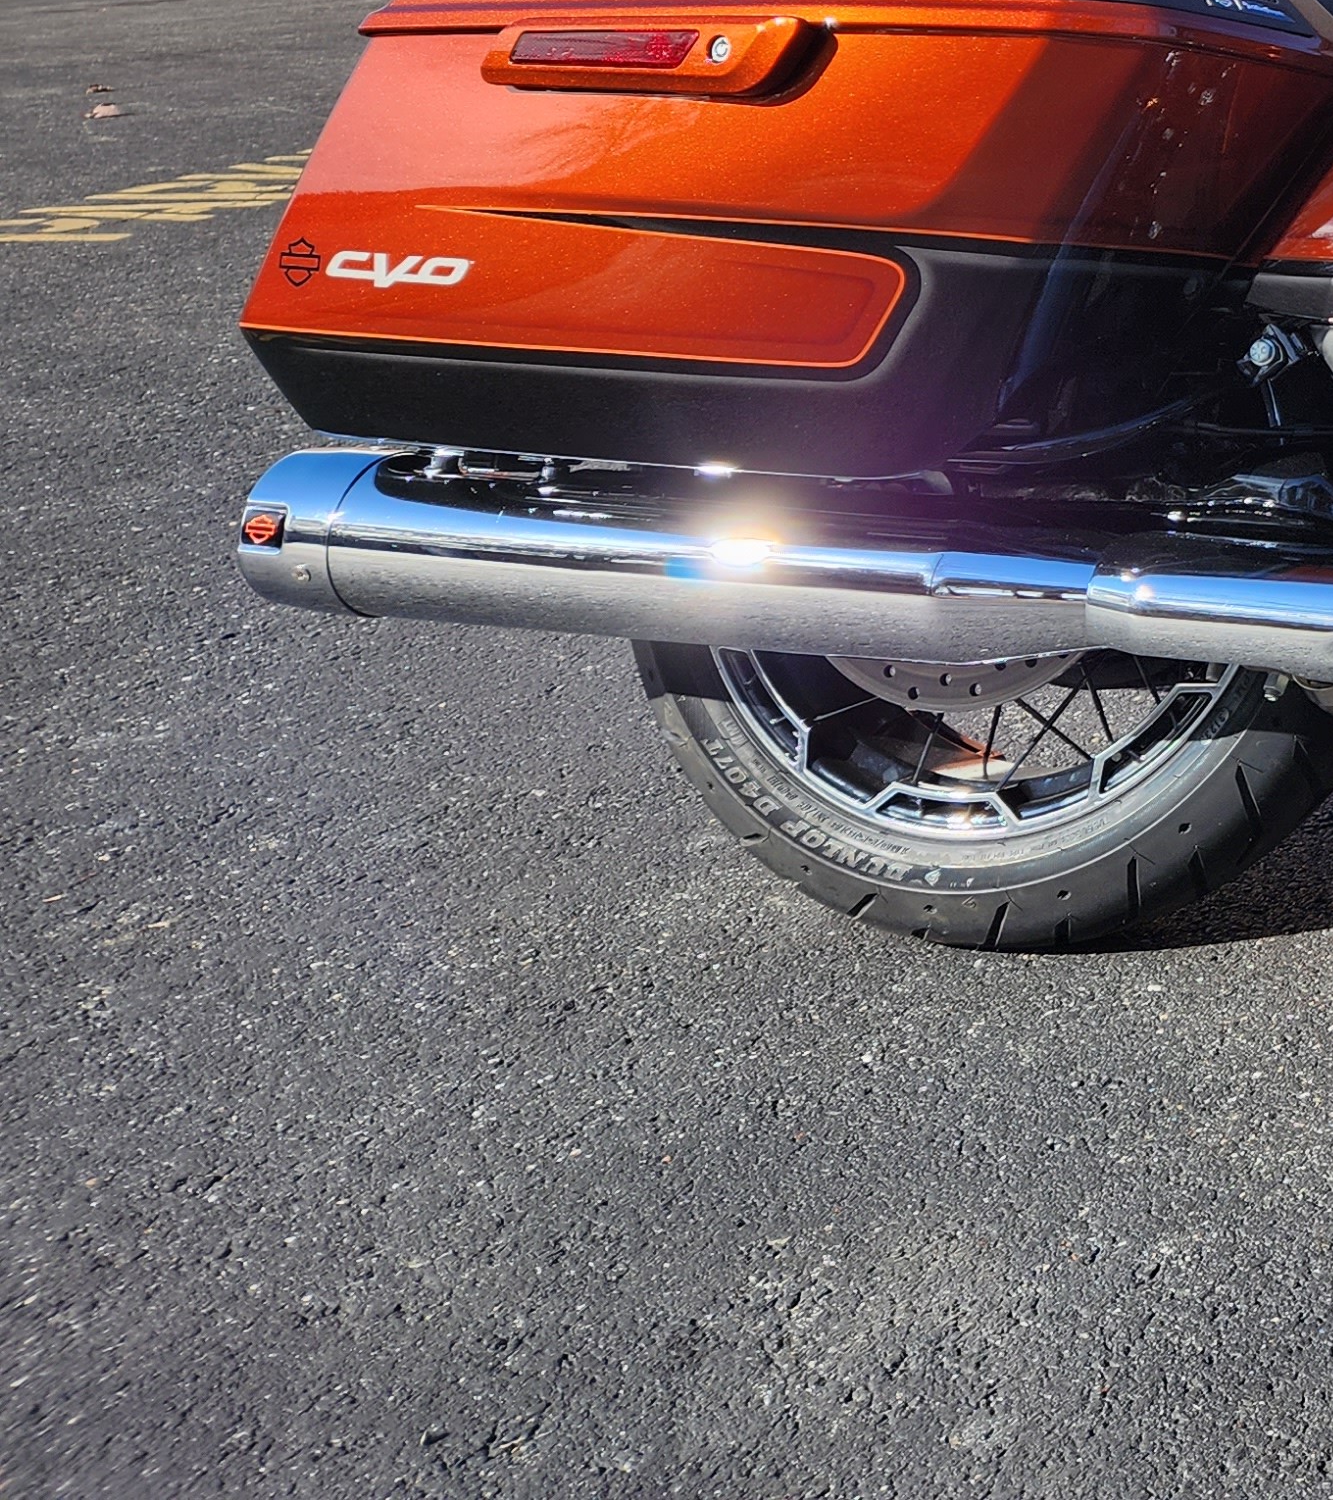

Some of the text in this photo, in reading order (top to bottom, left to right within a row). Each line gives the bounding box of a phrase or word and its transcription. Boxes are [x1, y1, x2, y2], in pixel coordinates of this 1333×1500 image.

[325, 250, 472, 288] CVO
[702, 737, 783, 817] D407T
[779, 819, 914, 882] DUNLOP
